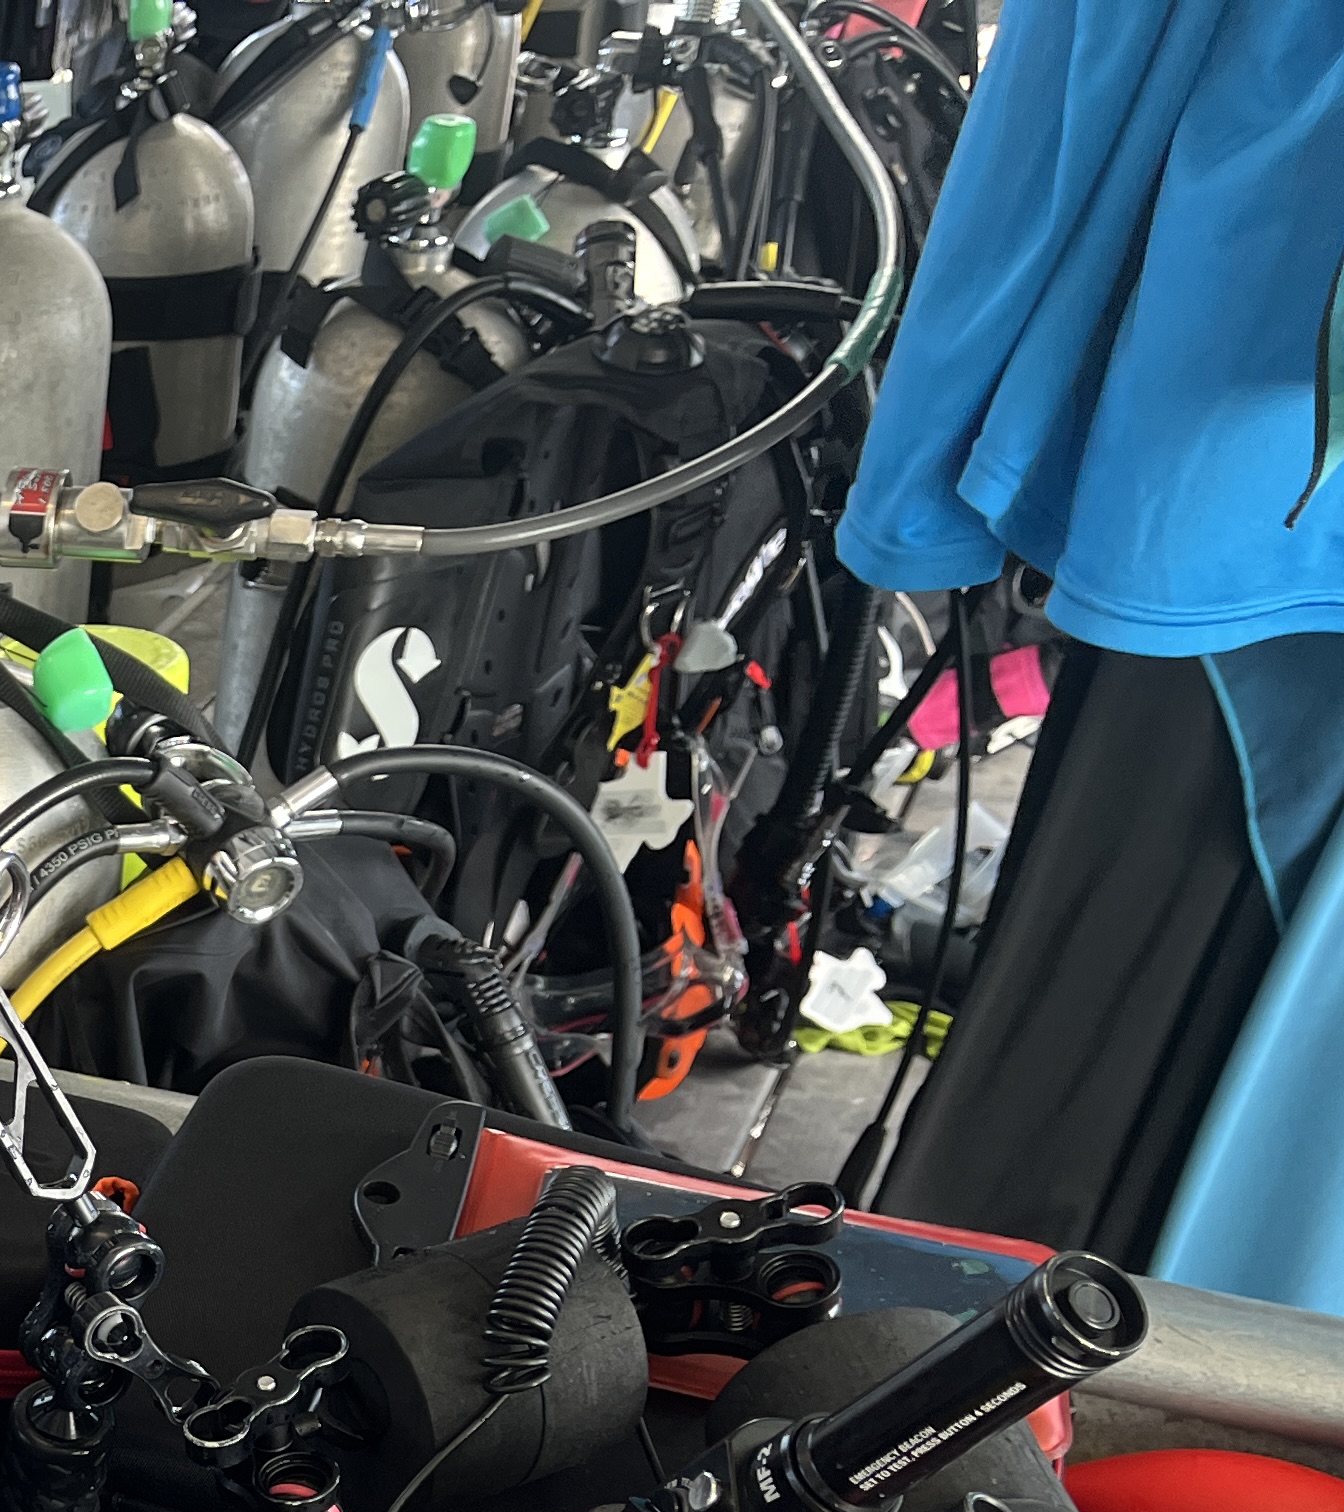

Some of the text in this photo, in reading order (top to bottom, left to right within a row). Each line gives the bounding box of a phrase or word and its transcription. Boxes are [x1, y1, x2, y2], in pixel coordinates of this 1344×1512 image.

[323, 620, 345, 668] PRO
[38, 851, 69, 879] 4350
[67, 832, 104, 857] PSIG
[848, 1425, 937, 1485] EMERGENCY BEACON
[859, 1477, 879, 1492] SET
[875, 1469, 891, 1481] TO
[910, 1436, 942, 1460] PRESS
[937, 1413, 978, 1441] BUTTON
[973, 1408, 984, 1418] 4
[979, 1381, 1027, 1413] SECONDS
[756, 1442, 781, 1503] MF-2
